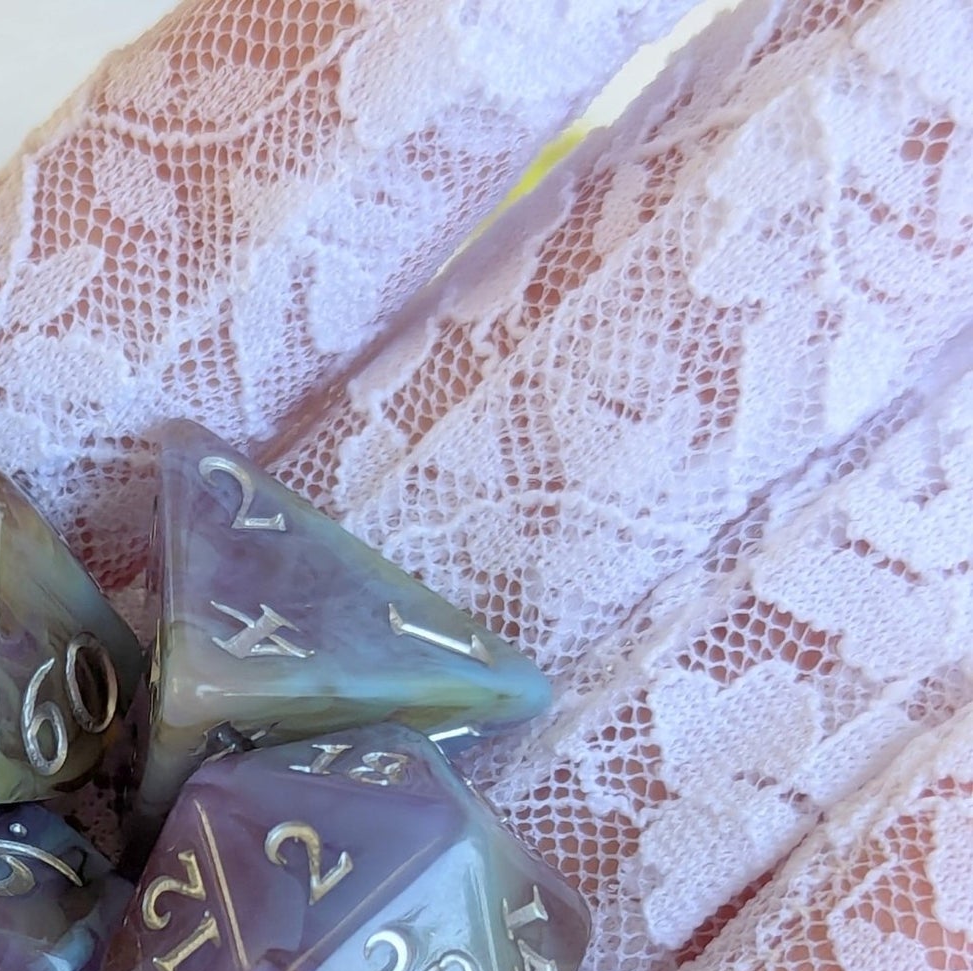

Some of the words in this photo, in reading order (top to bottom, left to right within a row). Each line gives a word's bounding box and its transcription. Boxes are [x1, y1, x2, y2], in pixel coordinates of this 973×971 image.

[198, 455, 287, 532] 2
[210, 601, 315, 659] 4
[388, 602, 495, 667] 1
[21, 632, 118, 776] 60
[264, 821, 353, 906] 2
